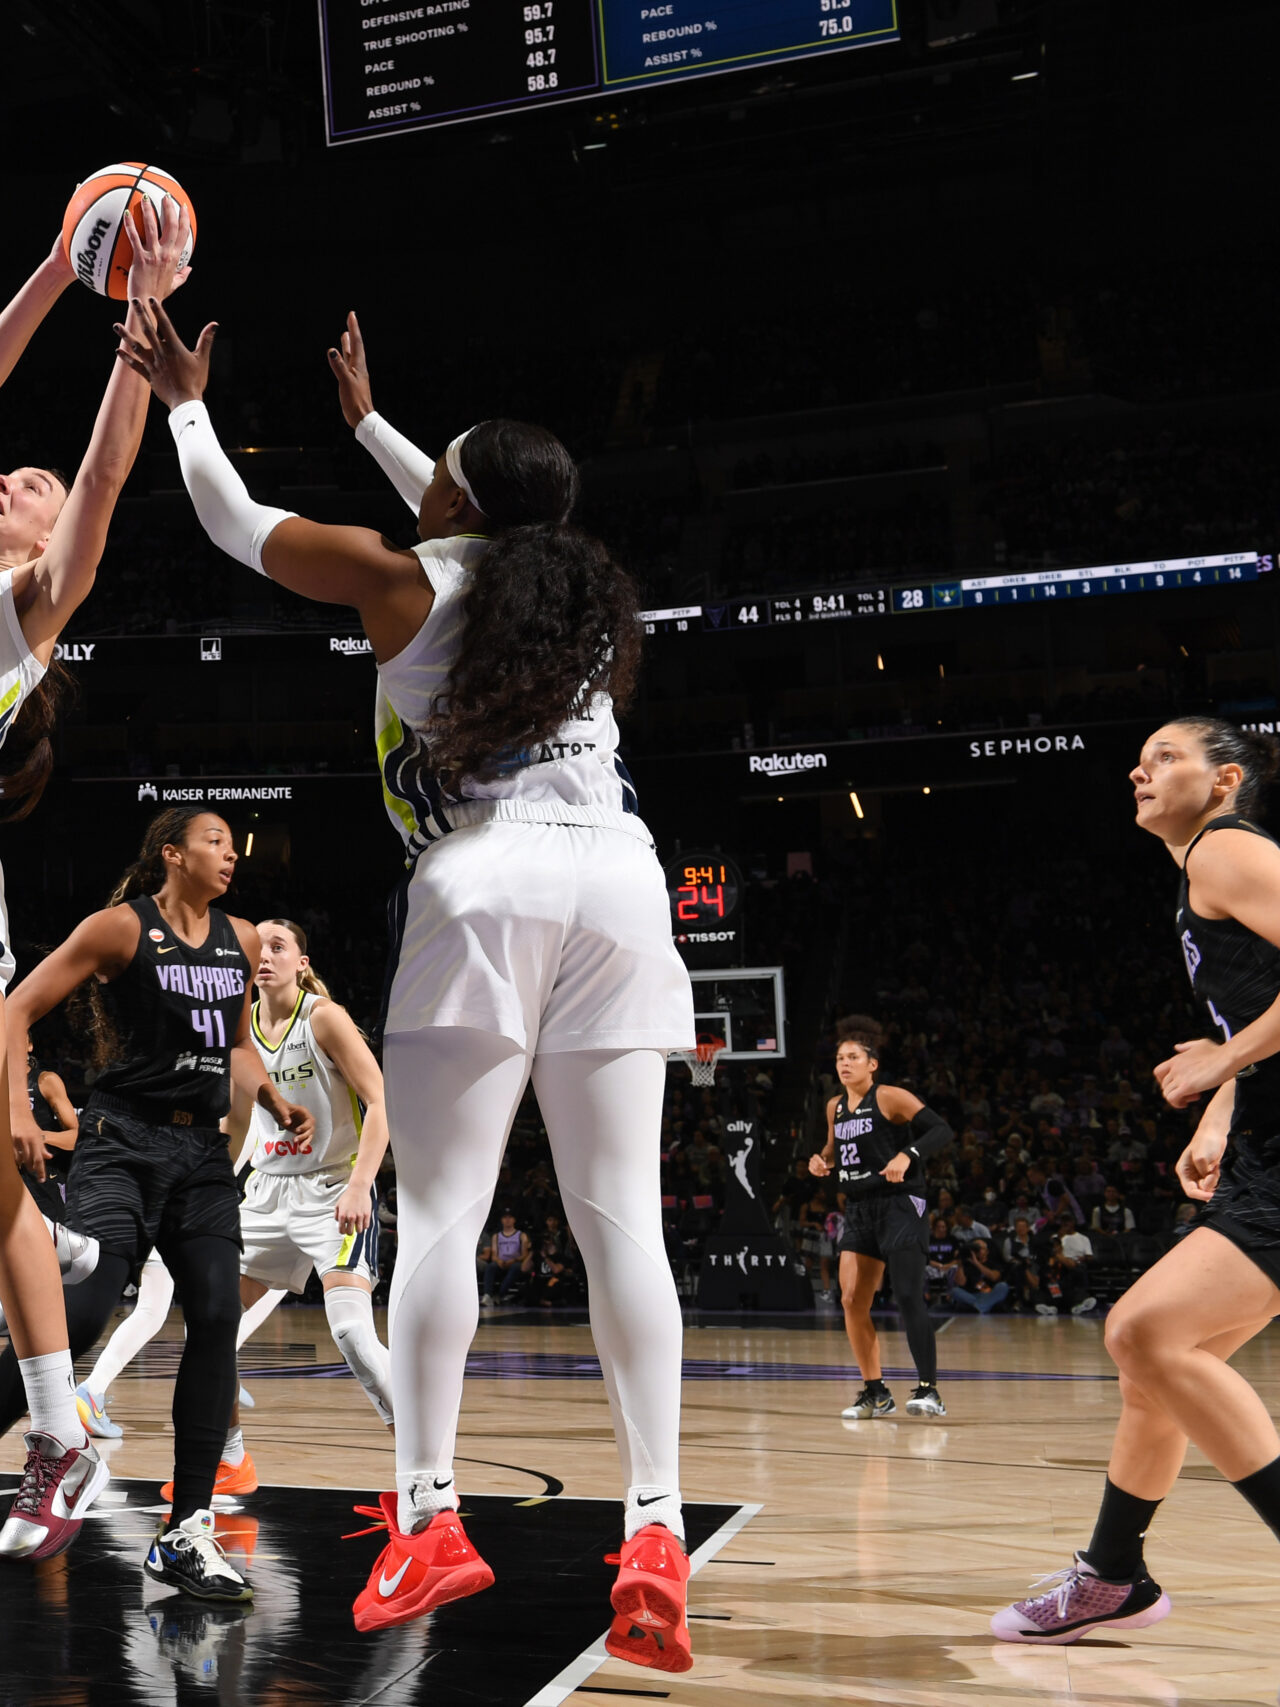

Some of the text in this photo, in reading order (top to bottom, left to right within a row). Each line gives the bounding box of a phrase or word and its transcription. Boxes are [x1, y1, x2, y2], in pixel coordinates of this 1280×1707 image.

[362, 0, 470, 29] DEFENSIVE RATING
[641, 5, 673, 20] PACE
[363, 37, 392, 51] TRUE
[394, 25, 455, 45] SHOOTING
[523, 2, 554, 22] 59.7
[642, 23, 702, 44] REBOUND
[365, 25, 555, 74] PACE 95.7
[644, 50, 688, 67] ASSIST
[819, 16, 853, 36] 75.0
[366, 78, 421, 97] REBOUND
[526, 49, 557, 68] 48.7
[368, 103, 408, 119] ASSIST
[527, 72, 558, 92] 58.8
[1011, 589, 1017, 600] 1
[1044, 585, 1057, 597] 14
[1121, 578, 1126, 590] 1
[1193, 571, 1201, 582] 4
[1228, 567, 1242, 579] 14
[795, 598, 801, 608] 4
[813, 594, 845, 613] 9:41
[878, 590, 885, 601] 3
[902, 590, 924, 608] 28
[738, 605, 759, 624] 44
[645, 620, 688, 634] 13 10
[970, 734, 1085, 758] SEPHORA
[750, 752, 827, 774] Rakuten
[163, 786, 292, 801] KAISER PERMANENTE
[684, 865, 726, 885] 9:41
[677, 885, 725, 920] 24
[687, 931, 736, 943] TISSOT
[155, 964, 245, 1003] VALKYRIES
[191, 1009, 226, 1047] 41
[268, 1061, 314, 1083] NGS
[727, 1120, 753, 1134] ally
[840, 1143, 861, 1166] 22
